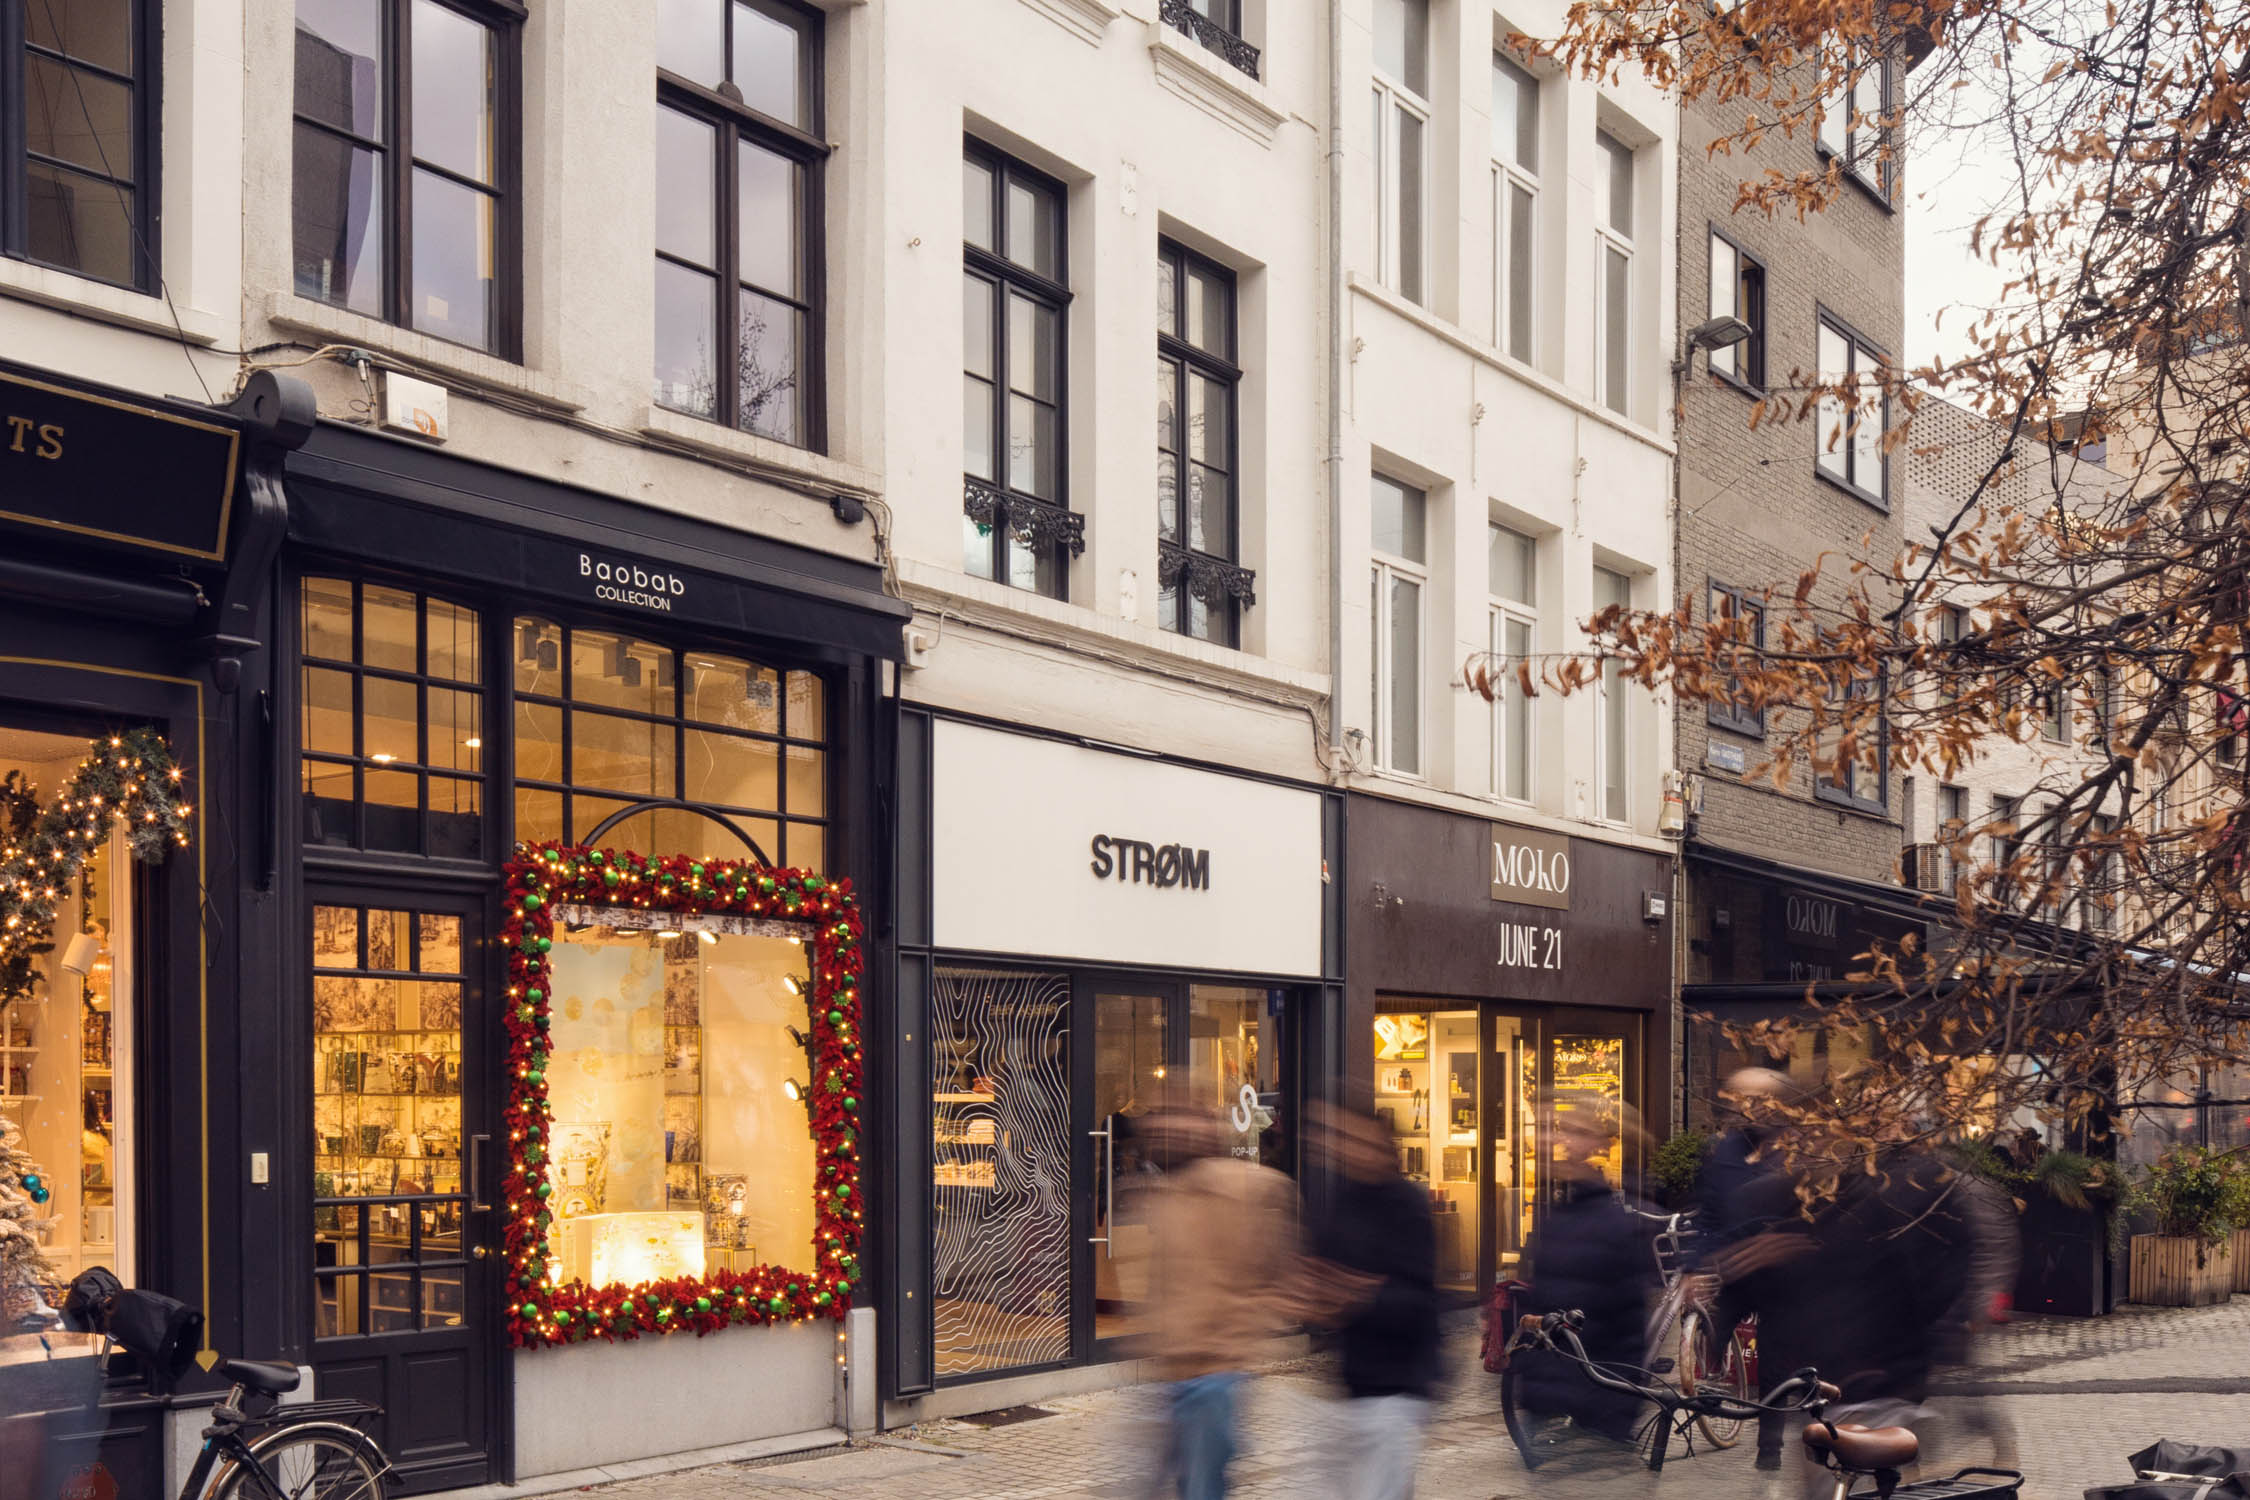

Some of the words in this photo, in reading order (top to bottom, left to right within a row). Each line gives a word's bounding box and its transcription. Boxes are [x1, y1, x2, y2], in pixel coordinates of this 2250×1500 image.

[7, 415, 65, 460] TS
[580, 553, 685, 595] Baobab
[595, 584, 671, 611] COLLECTION
[1090, 833, 1210, 891] STRØM
[1497, 922, 1539, 968] JUNE
[1543, 928, 1562, 970] 21
[1231, 1146, 1259, 1157] POP-UP
